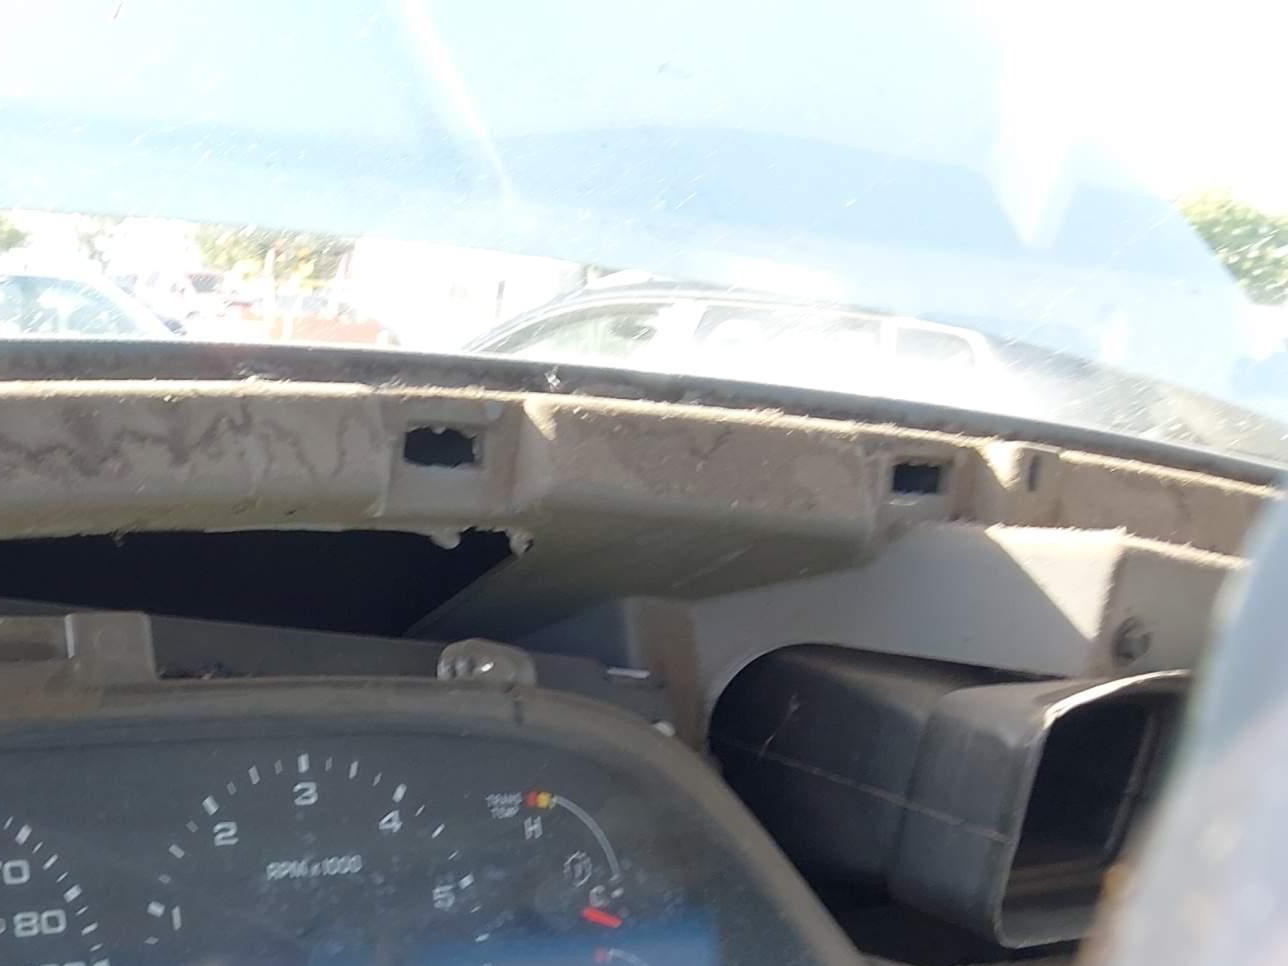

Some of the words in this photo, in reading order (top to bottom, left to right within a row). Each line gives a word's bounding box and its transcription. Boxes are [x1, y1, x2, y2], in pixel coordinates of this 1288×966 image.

[292, 781, 318, 806] 3
[213, 821, 239, 846] 2
[378, 809, 403, 833] 4
[524, 816, 543, 840] H
[266, 860, 308, 880] RPM
[432, 884, 456, 910] 5
[589, 885, 608, 907] C
[12, 909, 67, 938] 80
[170, 905, 182, 931] 1
